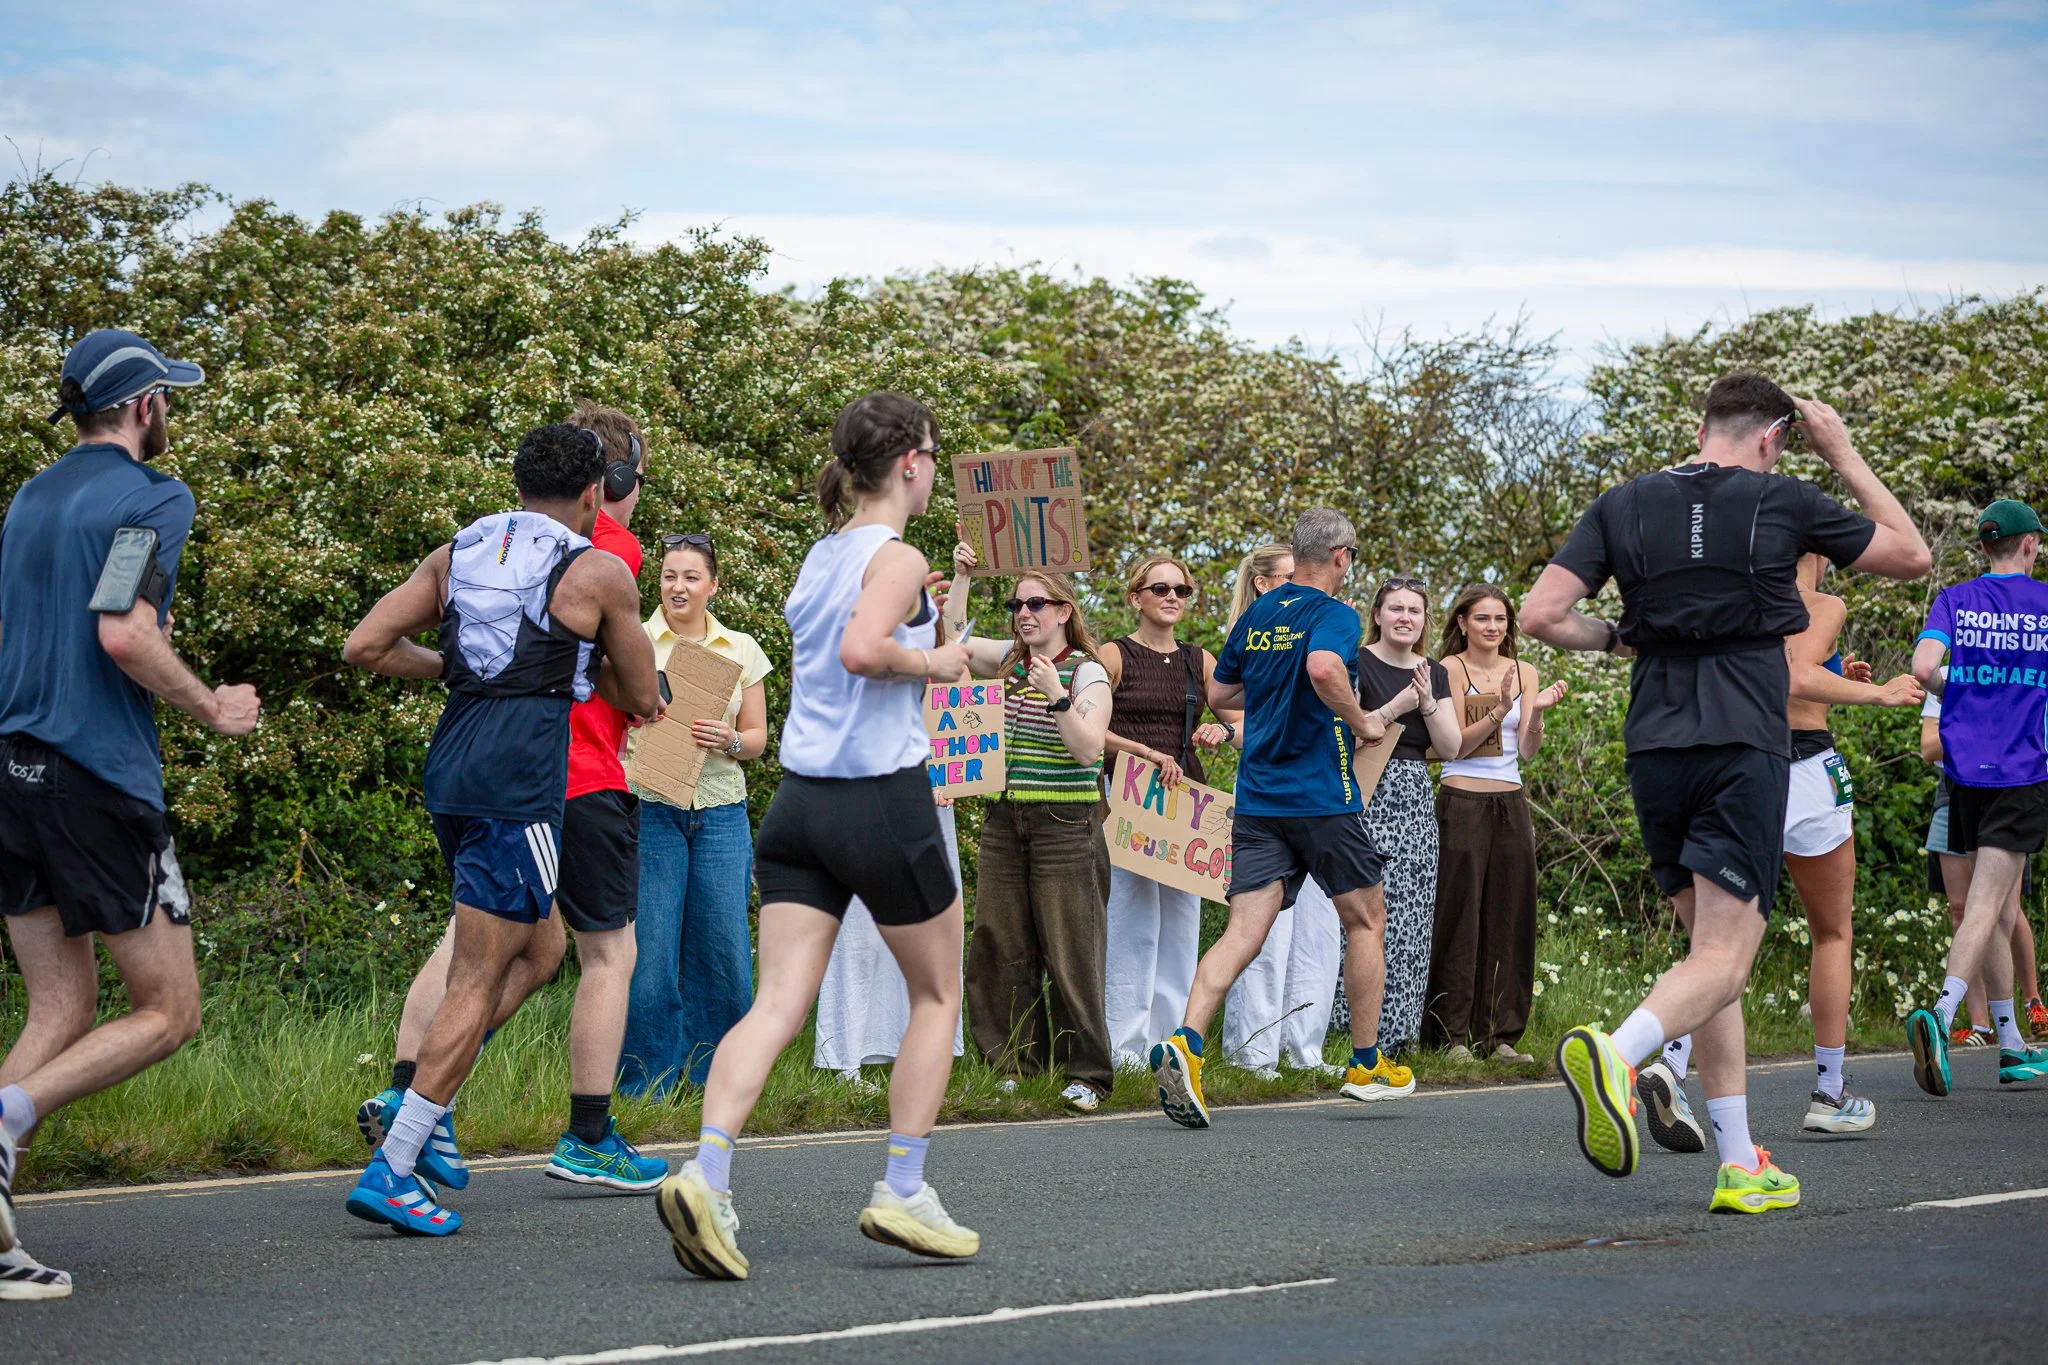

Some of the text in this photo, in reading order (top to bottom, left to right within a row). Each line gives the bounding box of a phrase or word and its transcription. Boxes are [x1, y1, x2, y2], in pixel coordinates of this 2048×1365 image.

[959, 456, 1073, 494] THINK OF THE
[500, 520, 517, 565] SALOMON
[985, 496, 1082, 569] PINTS!
[1691, 503, 1704, 558] KIPRUN
[1275, 626, 1290, 634] TATA
[1956, 609, 2037, 631] CROHN'S
[1956, 628, 2048, 652] COLITIS UK
[1950, 664, 2047, 689] MICHAEL
[932, 685, 1002, 710] HORSE
[937, 711, 957, 731] A
[928, 732, 999, 759] THON
[1123, 755, 1215, 830] KATY
